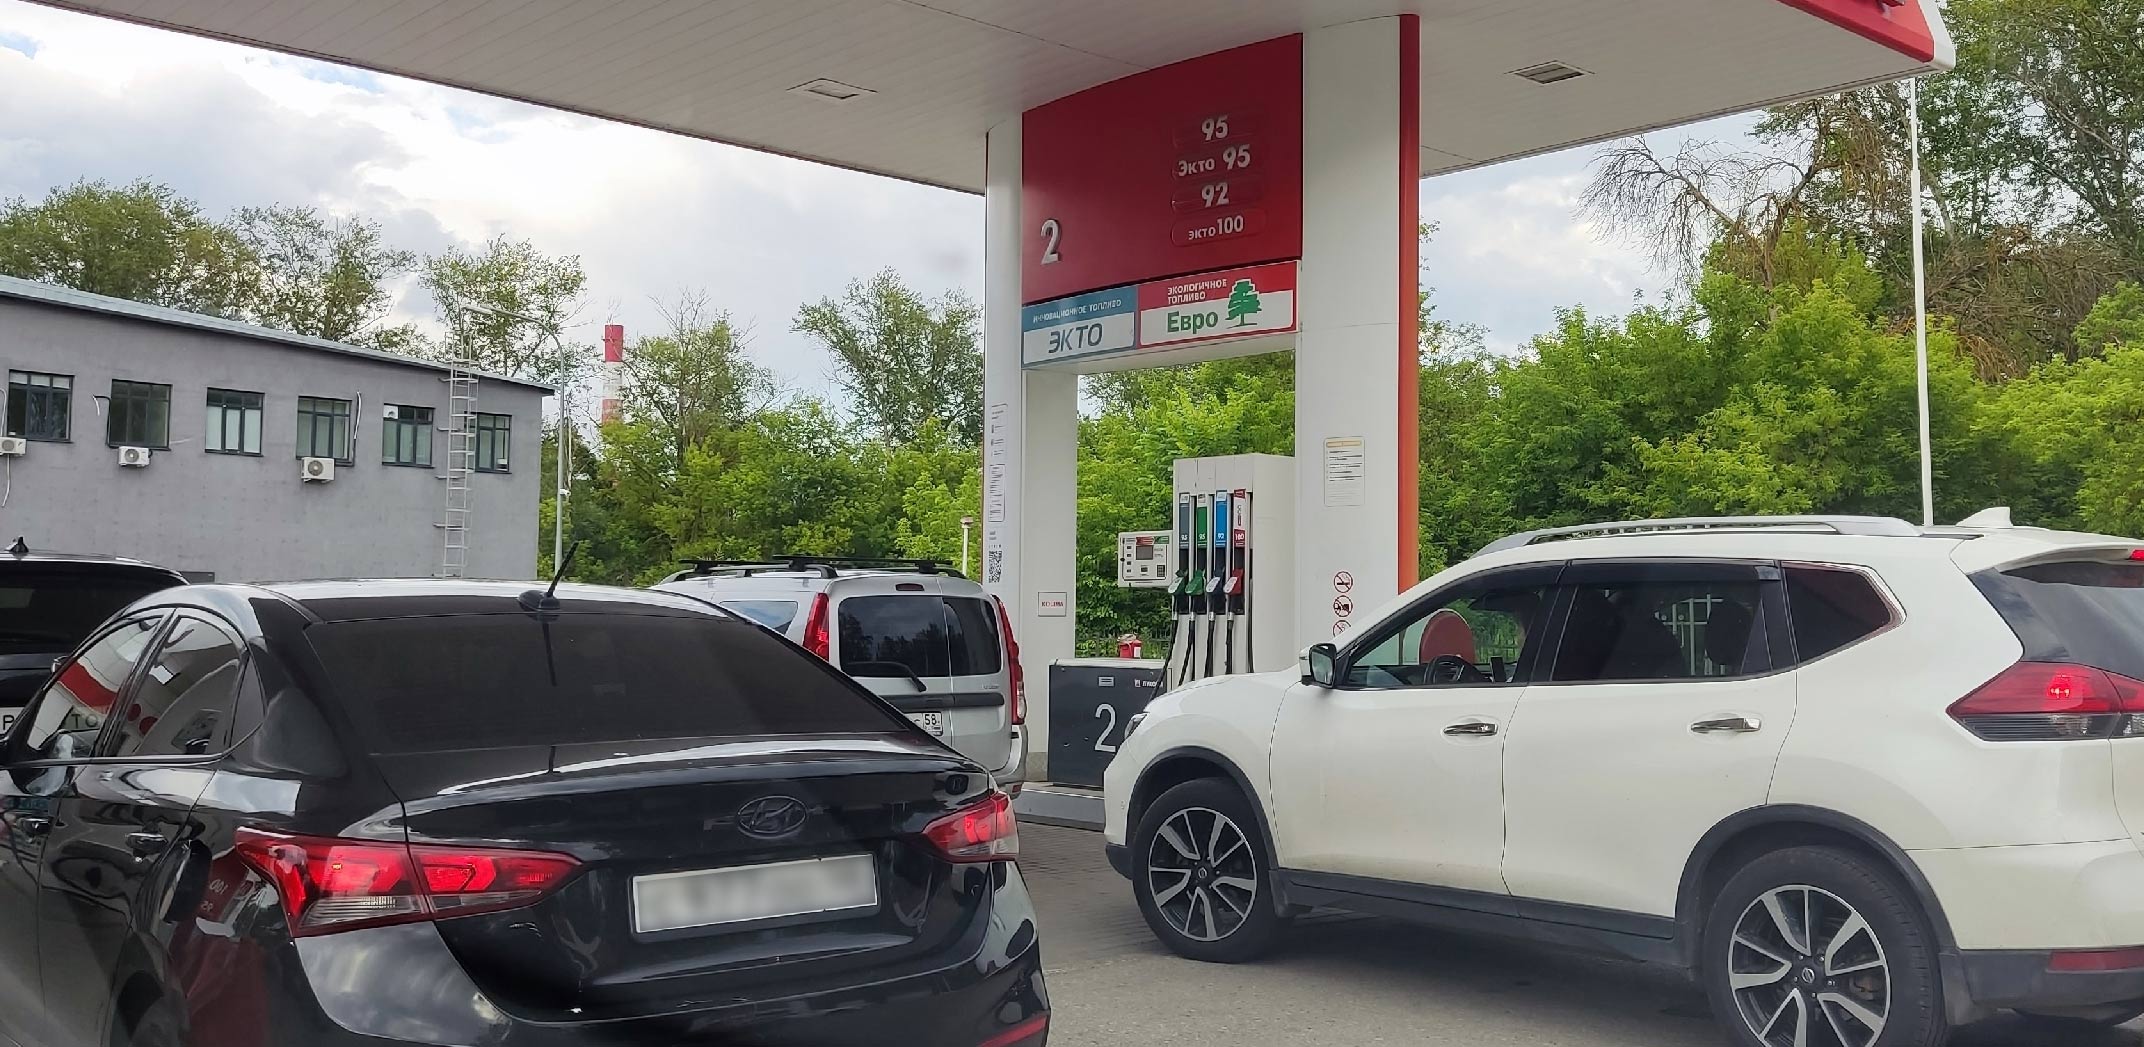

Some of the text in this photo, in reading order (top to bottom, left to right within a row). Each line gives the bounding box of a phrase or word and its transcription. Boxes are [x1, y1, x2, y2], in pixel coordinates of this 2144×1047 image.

[1201, 115, 1229, 141] 95
[1178, 144, 1251, 177] Экто 95
[1201, 182, 1230, 208] 92
[1040, 219, 1059, 265] 2
[1167, 278, 1228, 296] ЭКОЛОГИЧНОЕ
[1167, 292, 1206, 305] ТОПЛИВО
[1167, 311, 1219, 335] Евро
[1048, 322, 1103, 354] ЭКТО
[924, 713, 937, 726] 58
[1095, 703, 1116, 752] 2
